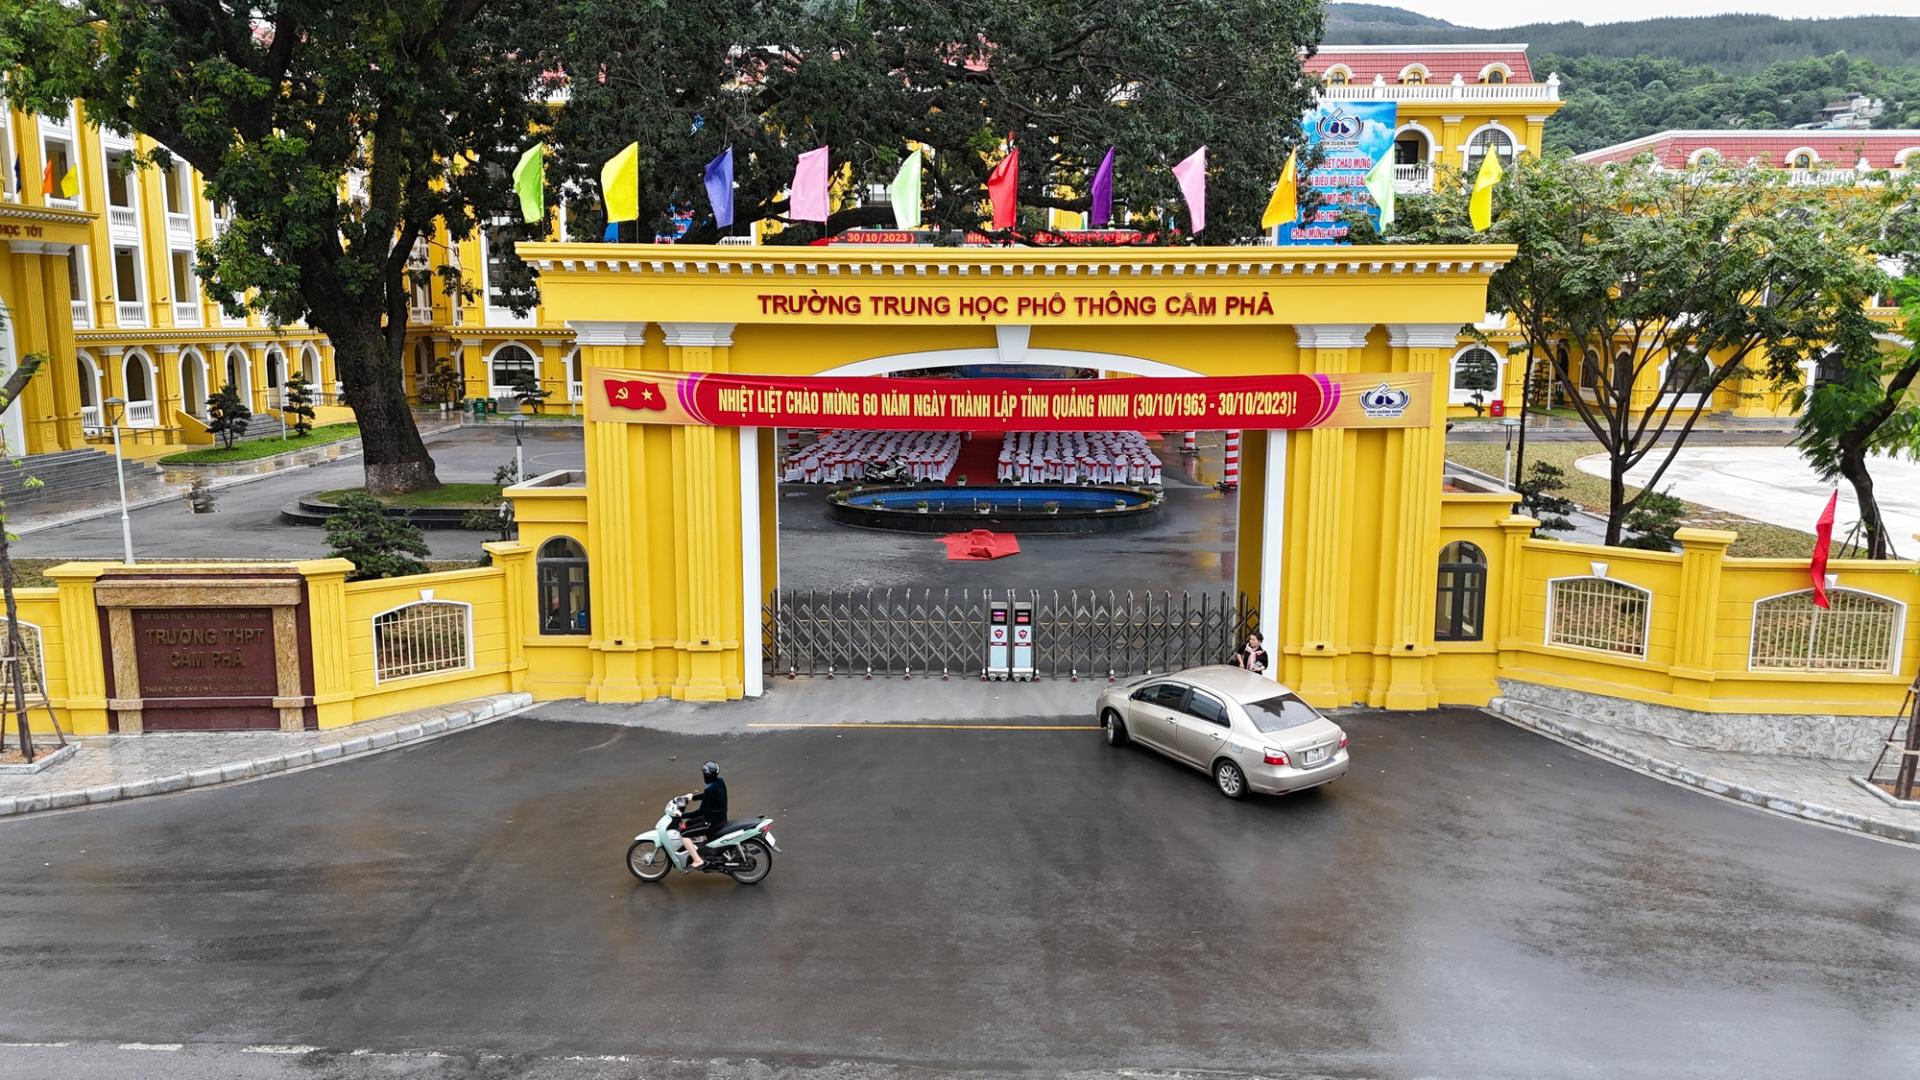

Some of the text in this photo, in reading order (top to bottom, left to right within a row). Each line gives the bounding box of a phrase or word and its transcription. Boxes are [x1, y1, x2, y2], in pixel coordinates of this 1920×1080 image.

[847, 232, 908, 243] 30/10/2023
[757, 289, 861, 315] TRƯỜNG
[869, 295, 951, 316] TRUNG
[959, 296, 1008, 321] HỌC
[1074, 290, 1157, 316] THÔNG
[1225, 291, 1274, 315] PHẢ
[718, 385, 754, 418] NHIỆT
[757, 386, 783, 418] LIỆT
[785, 387, 819, 414] CHÀO
[822, 388, 860, 416] MỪNG
[862, 393, 878, 416] 60
[881, 389, 910, 416] NĂM
[913, 390, 947, 417] NGÀY
[950, 390, 990, 417] THÀNH
[994, 390, 1017, 422] LẬP
[1020, 387, 1049, 417] TỈNH
[1052, 387, 1095, 420] QUẢNG
[1097, 394, 1129, 417] NINH
[1133, 393, 1207, 419] (30/10/1963
[1218, 391, 1297, 417] 30/10/2023)!
[145, 624, 264, 646] TRƯỜNG THPT
